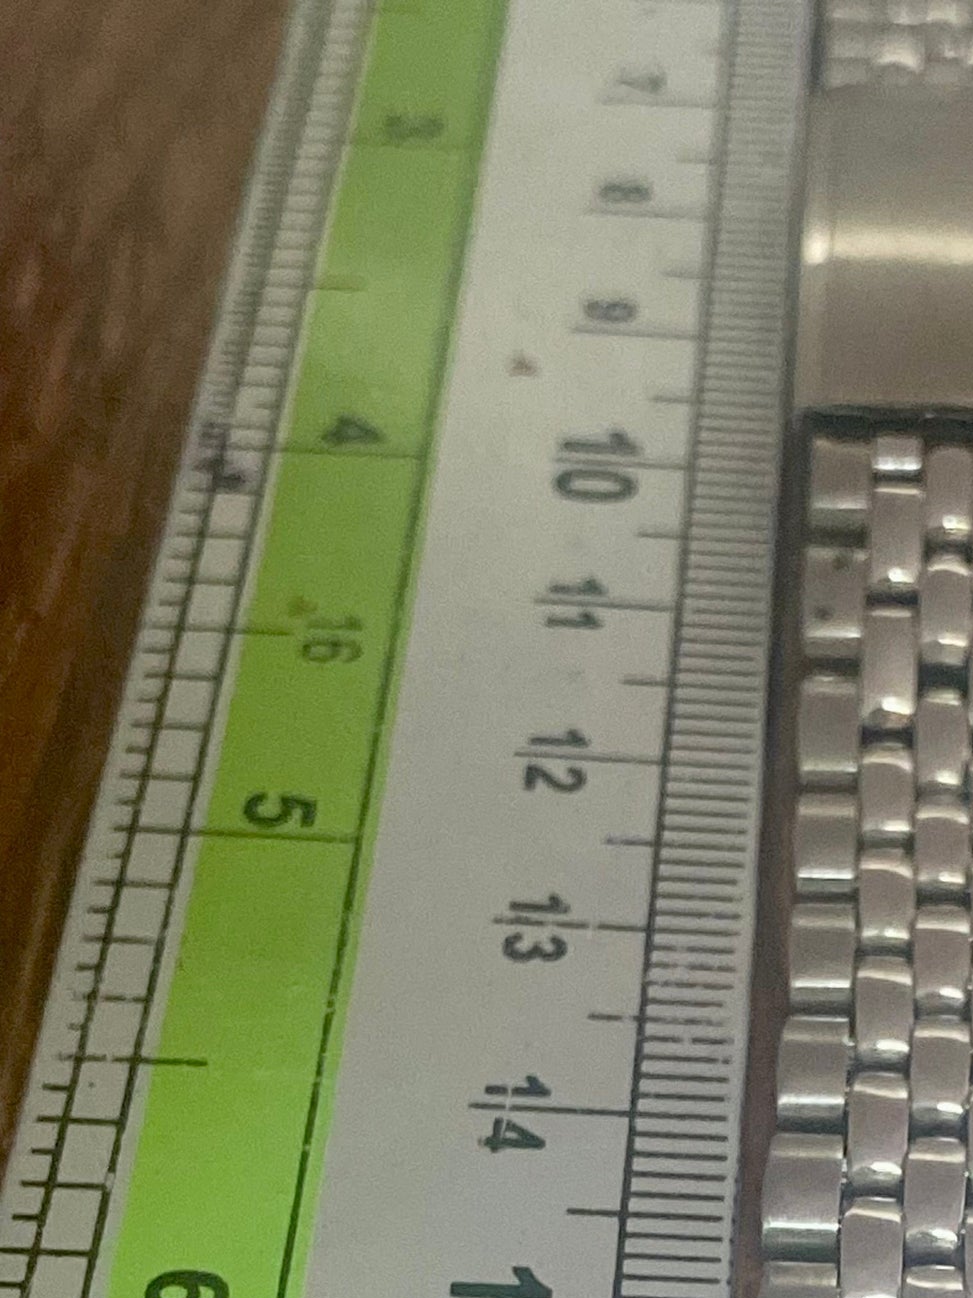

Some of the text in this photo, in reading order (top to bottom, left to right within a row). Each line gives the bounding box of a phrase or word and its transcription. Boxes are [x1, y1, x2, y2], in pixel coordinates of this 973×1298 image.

[320, 415, 384, 446] 4
[553, 430, 642, 502] 10
[543, 577, 606, 630] 11
[521, 728, 592, 794] 12
[242, 791, 318, 830] 5
[501, 893, 572, 964] 13
[479, 1075, 552, 1153] 14
